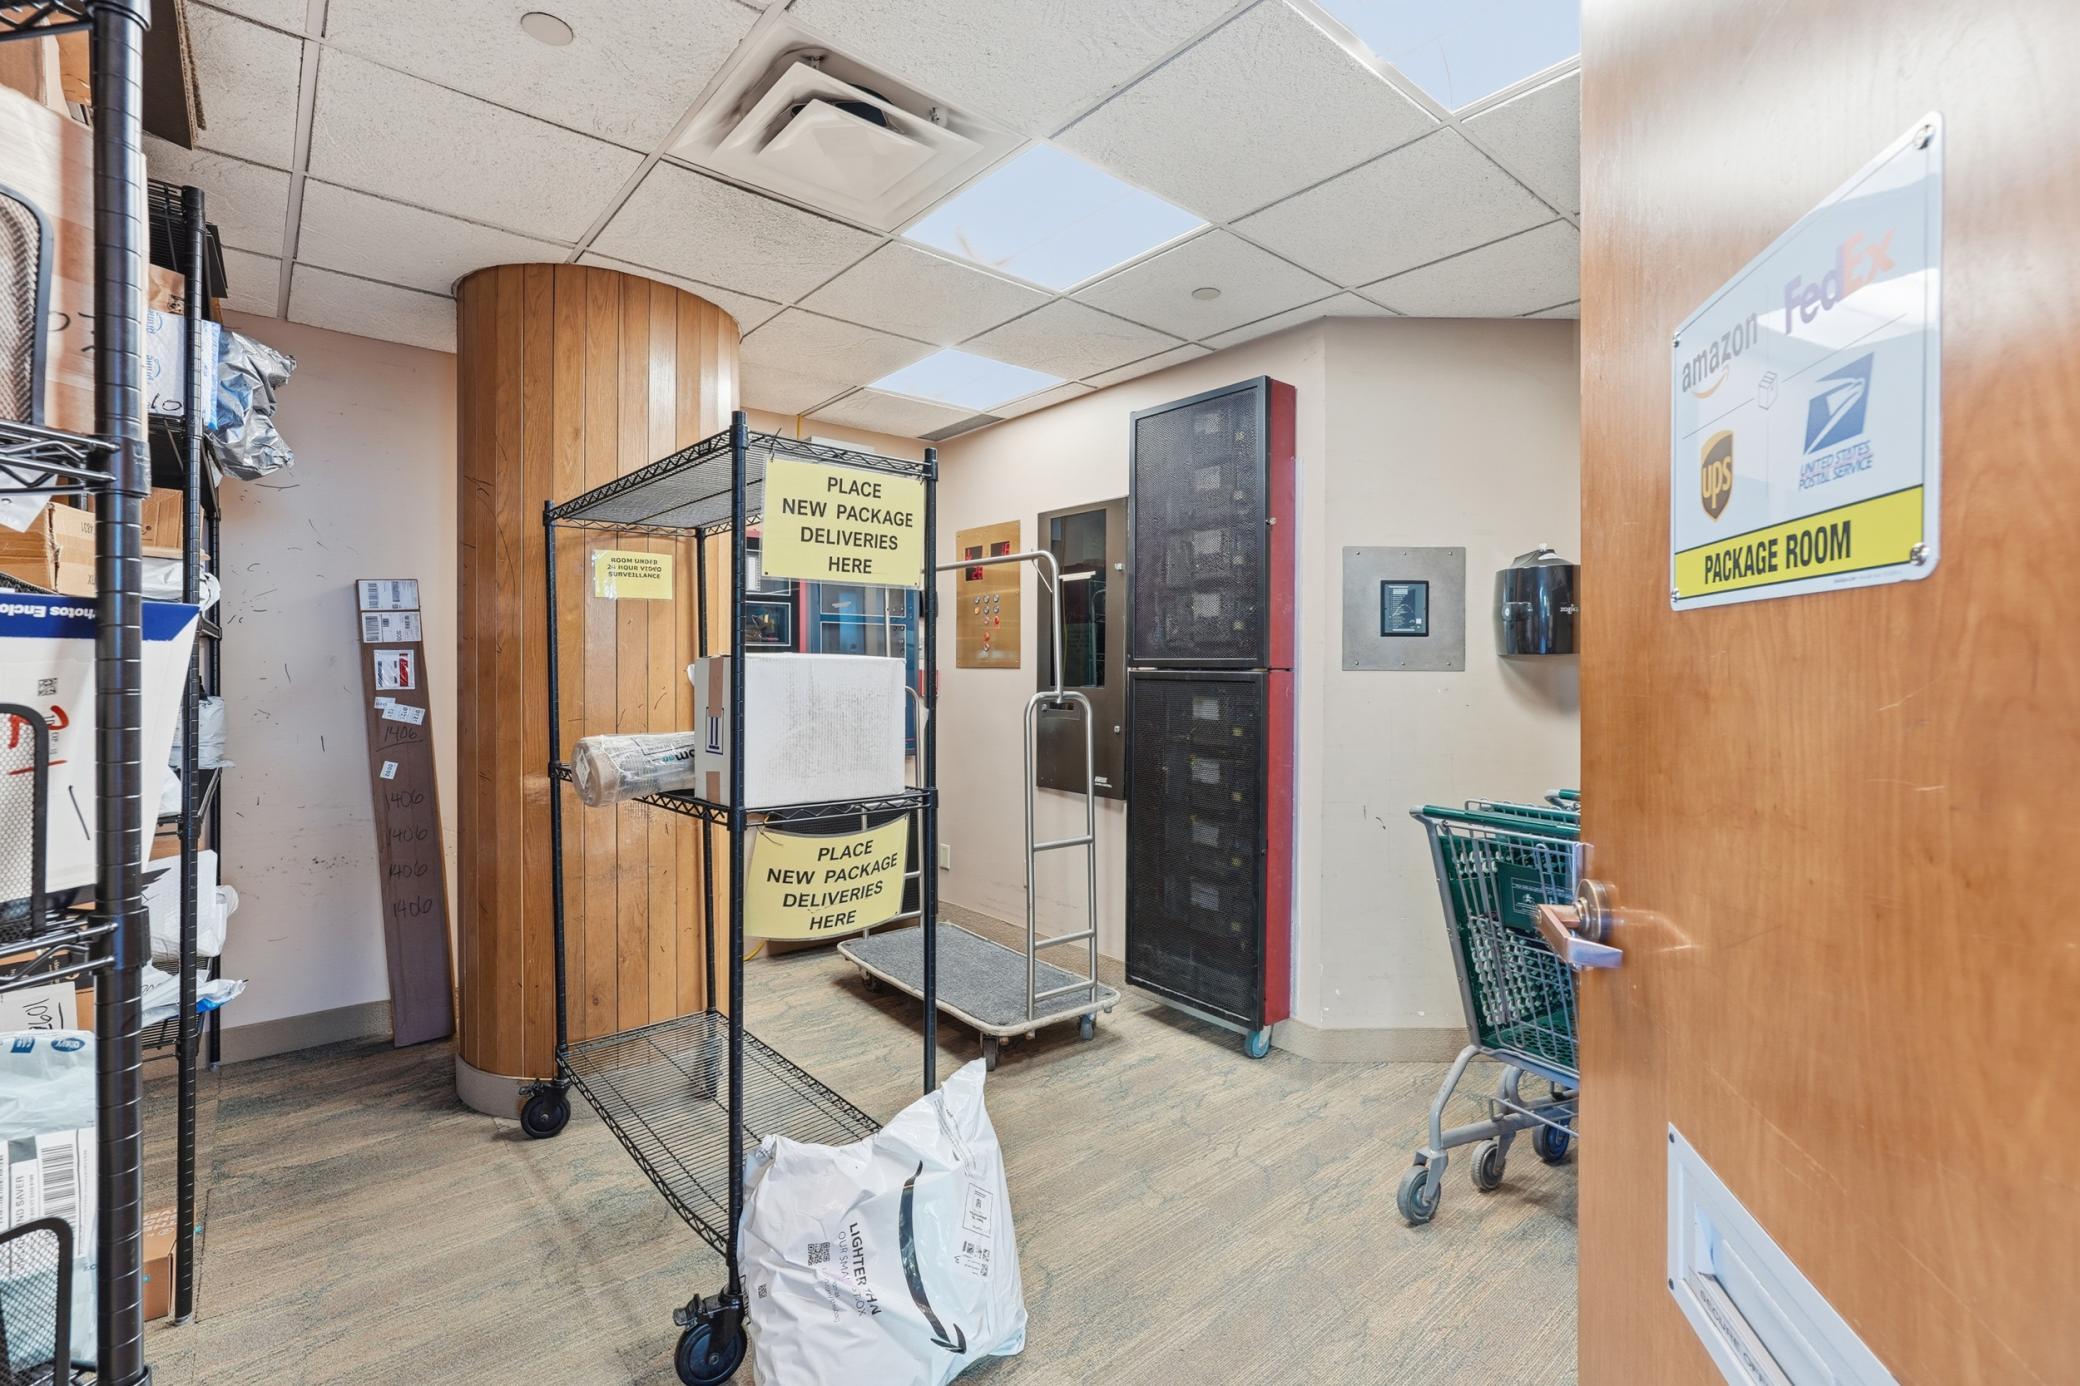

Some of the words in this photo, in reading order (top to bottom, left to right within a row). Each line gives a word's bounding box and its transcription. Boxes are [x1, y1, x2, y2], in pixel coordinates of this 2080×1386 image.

[1783, 227, 1896, 335] FedEx
[1681, 312, 1758, 394] amazon
[827, 476, 882, 500] PLACE
[1701, 453, 1733, 499] ups
[782, 497, 828, 517] NEW
[836, 504, 914, 528] PACKAGE
[800, 526, 899, 551] DELIVERIES
[1704, 537, 1779, 585] PACKAGE
[1785, 519, 1852, 570] ROOM
[828, 556, 873, 575] HERE
[50, 605, 96, 620] hotos
[384, 725, 419, 743] 1406
[386, 790, 424, 812] 1406
[387, 826, 428, 846] 1406
[817, 839, 874, 863] PLACE
[766, 867, 816, 886] NEW
[824, 853, 899, 883] PACKAGE
[782, 880, 884, 909] DELIVERIES
[809, 910, 857, 931] HERE
[849, 1222, 867, 1286] LIGHTER
